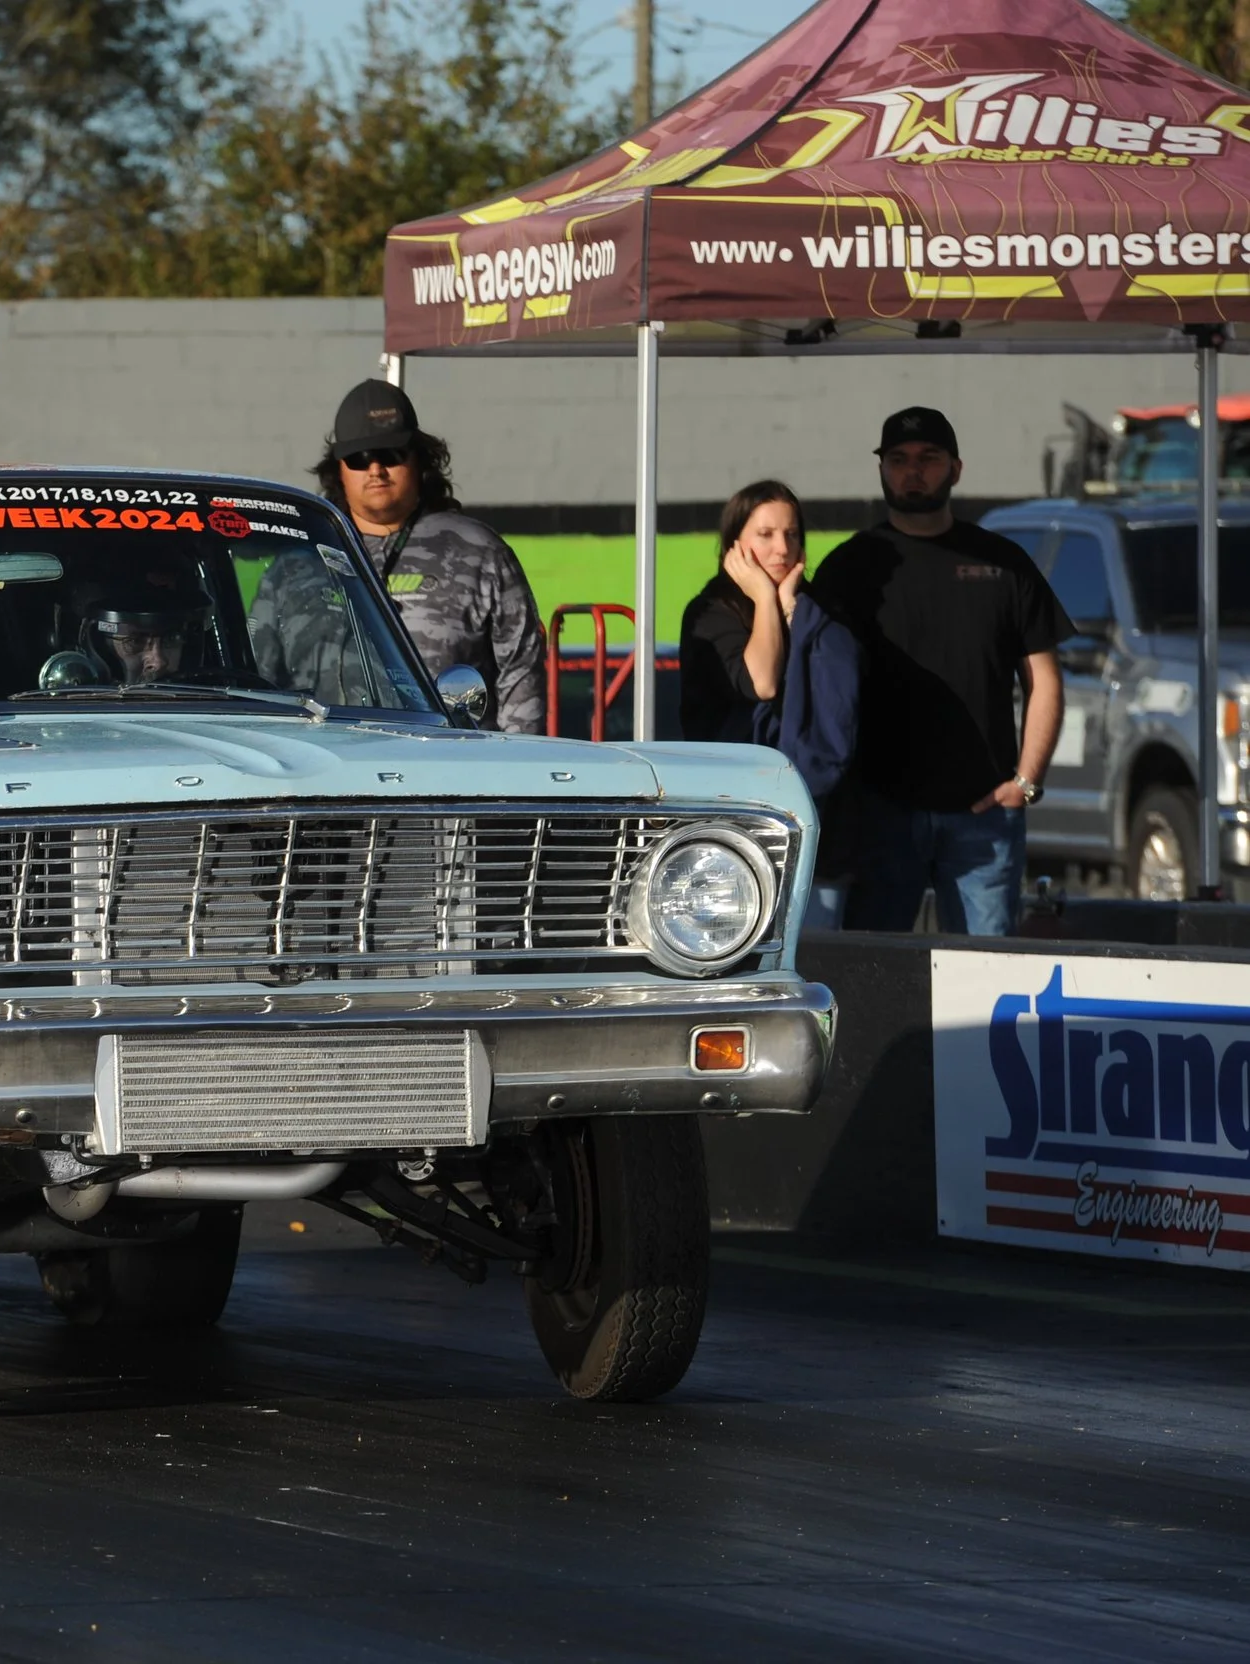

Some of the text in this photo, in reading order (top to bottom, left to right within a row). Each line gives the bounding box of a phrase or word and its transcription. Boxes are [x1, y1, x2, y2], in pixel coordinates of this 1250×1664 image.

[836, 73, 1223, 160] Willie's
[896, 145, 1191, 166] Monster Shirts
[412, 240, 616, 305] www.raceosw.com
[212, 496, 297, 511] OVERDRIVE
[248, 521, 309, 540] BRAKES
[1073, 1160, 1223, 1257] Engineering
